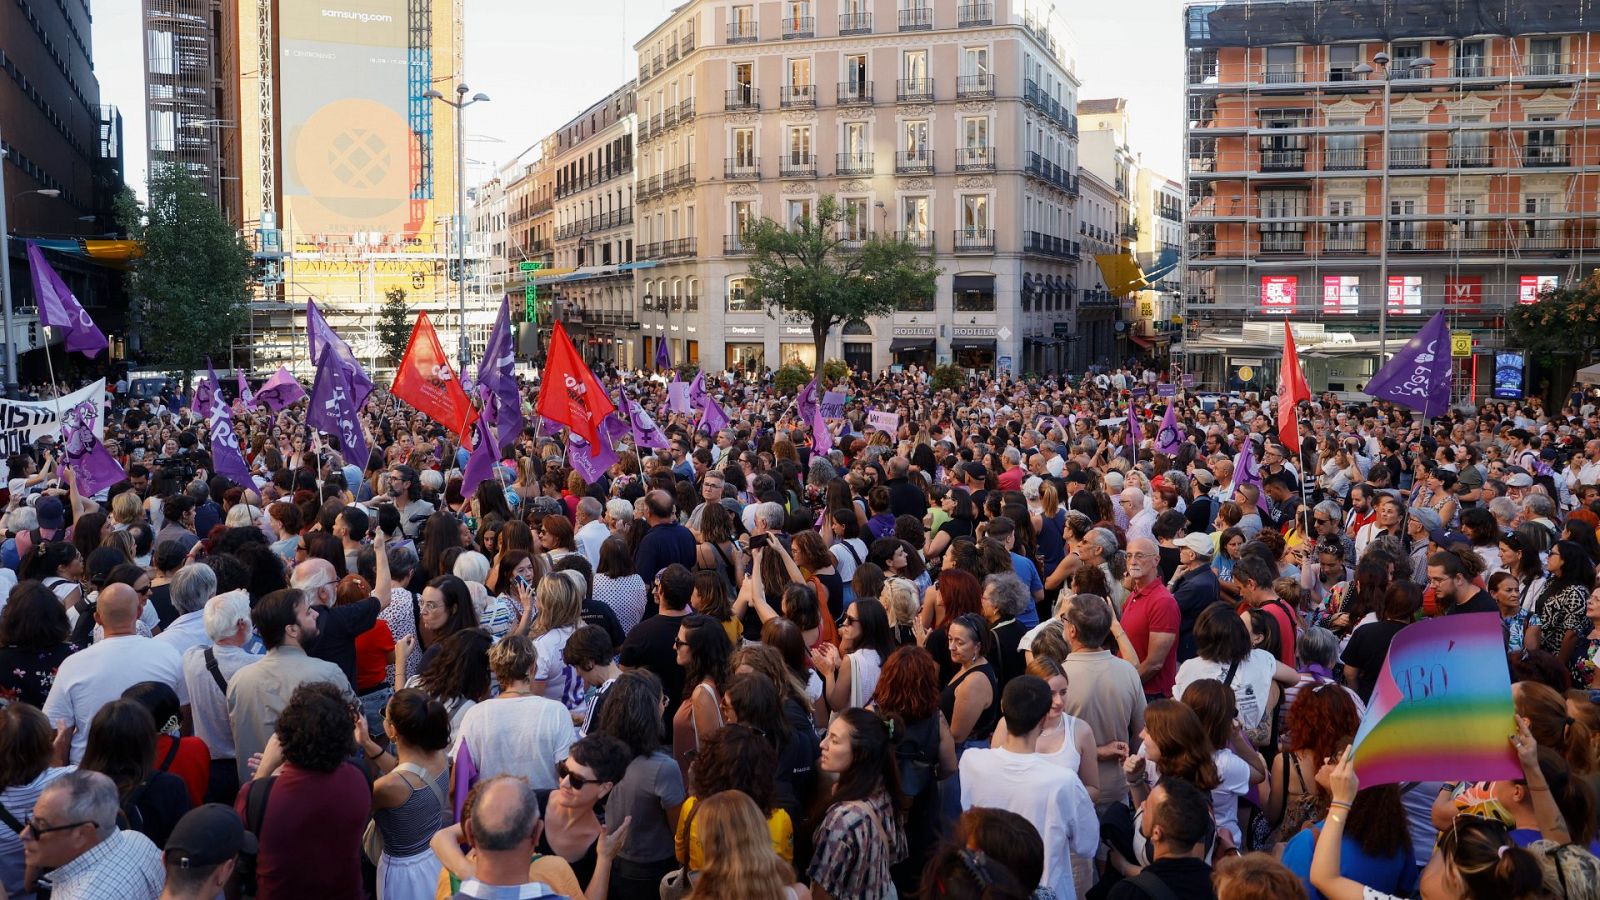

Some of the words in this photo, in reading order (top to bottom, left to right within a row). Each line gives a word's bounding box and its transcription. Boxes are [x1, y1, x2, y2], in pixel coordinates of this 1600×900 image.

[322, 8, 392, 22] samsung.com
[1141, 309, 1153, 317] COS
[894, 328, 935, 336] RODILLA
[953, 328, 995, 336] RODILLA
